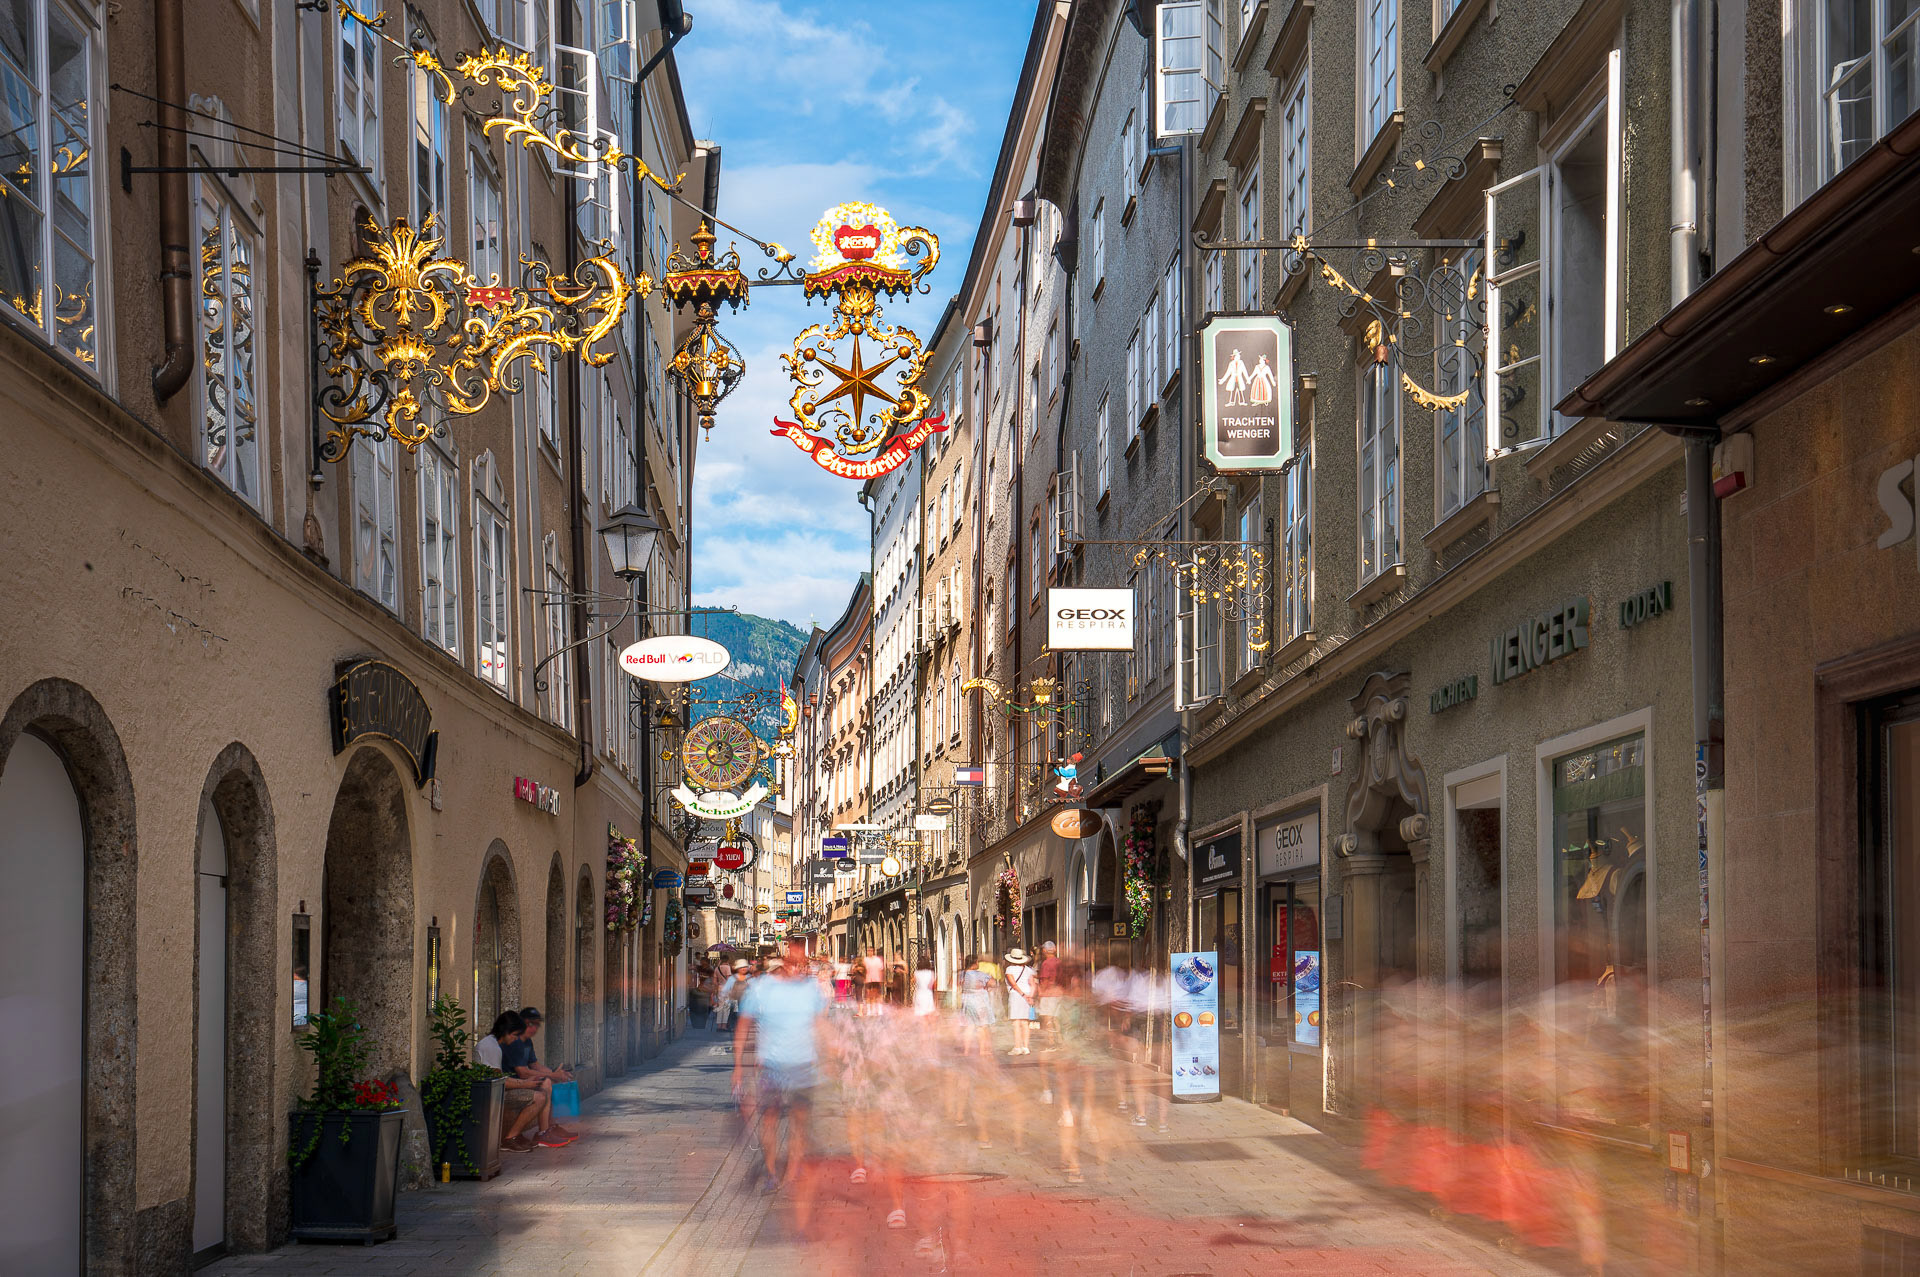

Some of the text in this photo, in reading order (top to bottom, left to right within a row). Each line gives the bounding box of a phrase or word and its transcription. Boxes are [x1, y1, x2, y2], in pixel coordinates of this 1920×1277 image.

[1222, 417, 1275, 426] TRACHTEN
[1227, 429, 1271, 438] WENGER
[785, 422, 934, 478] 1720 Sternbräu 2014
[1057, 608, 1126, 620] GEOX
[1056, 621, 1126, 629] RESPIRA
[1489, 595, 1592, 685] WENGER
[1619, 581, 1671, 630] LODEN
[626, 652, 723, 664] Red Bull WORLD
[689, 800, 752, 815] Aschauer
[1275, 824, 1304, 850] GEOX
[725, 853, 741, 861] YUEN
[1275, 850, 1304, 867] RESPIRA
